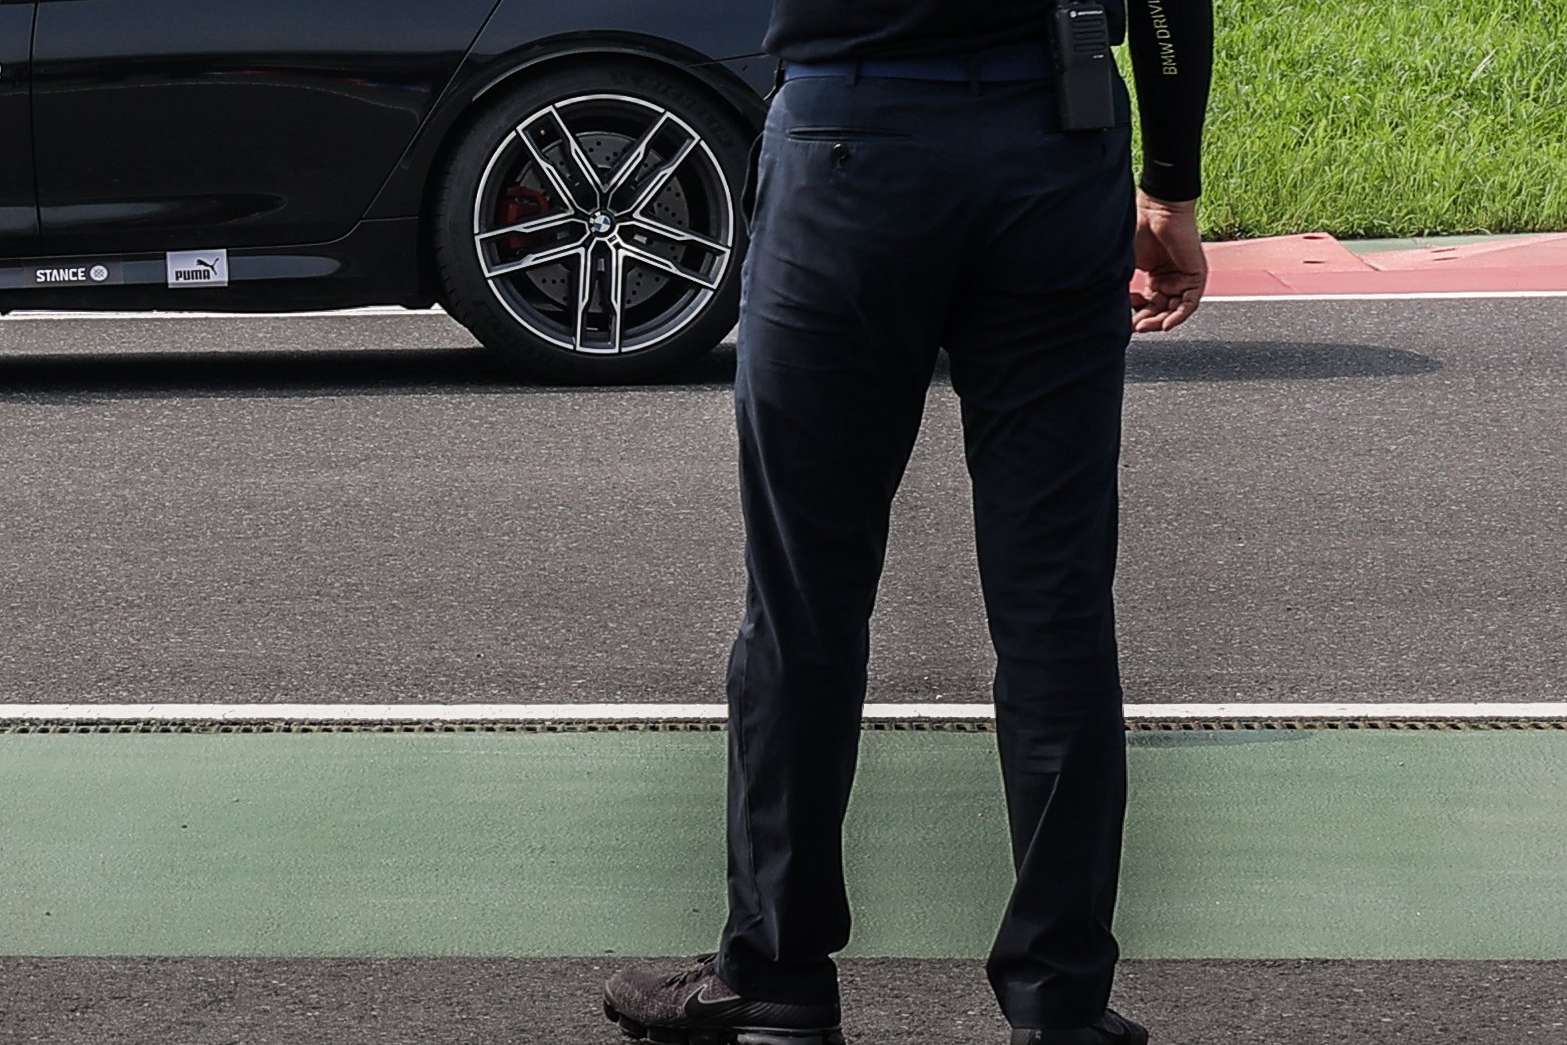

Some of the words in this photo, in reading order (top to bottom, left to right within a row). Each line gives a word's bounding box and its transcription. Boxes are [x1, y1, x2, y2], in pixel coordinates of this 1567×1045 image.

[1162, 43, 1178, 75] BMW
[36, 267, 87, 283] STANCE
[175, 269, 211, 281] PUMA
